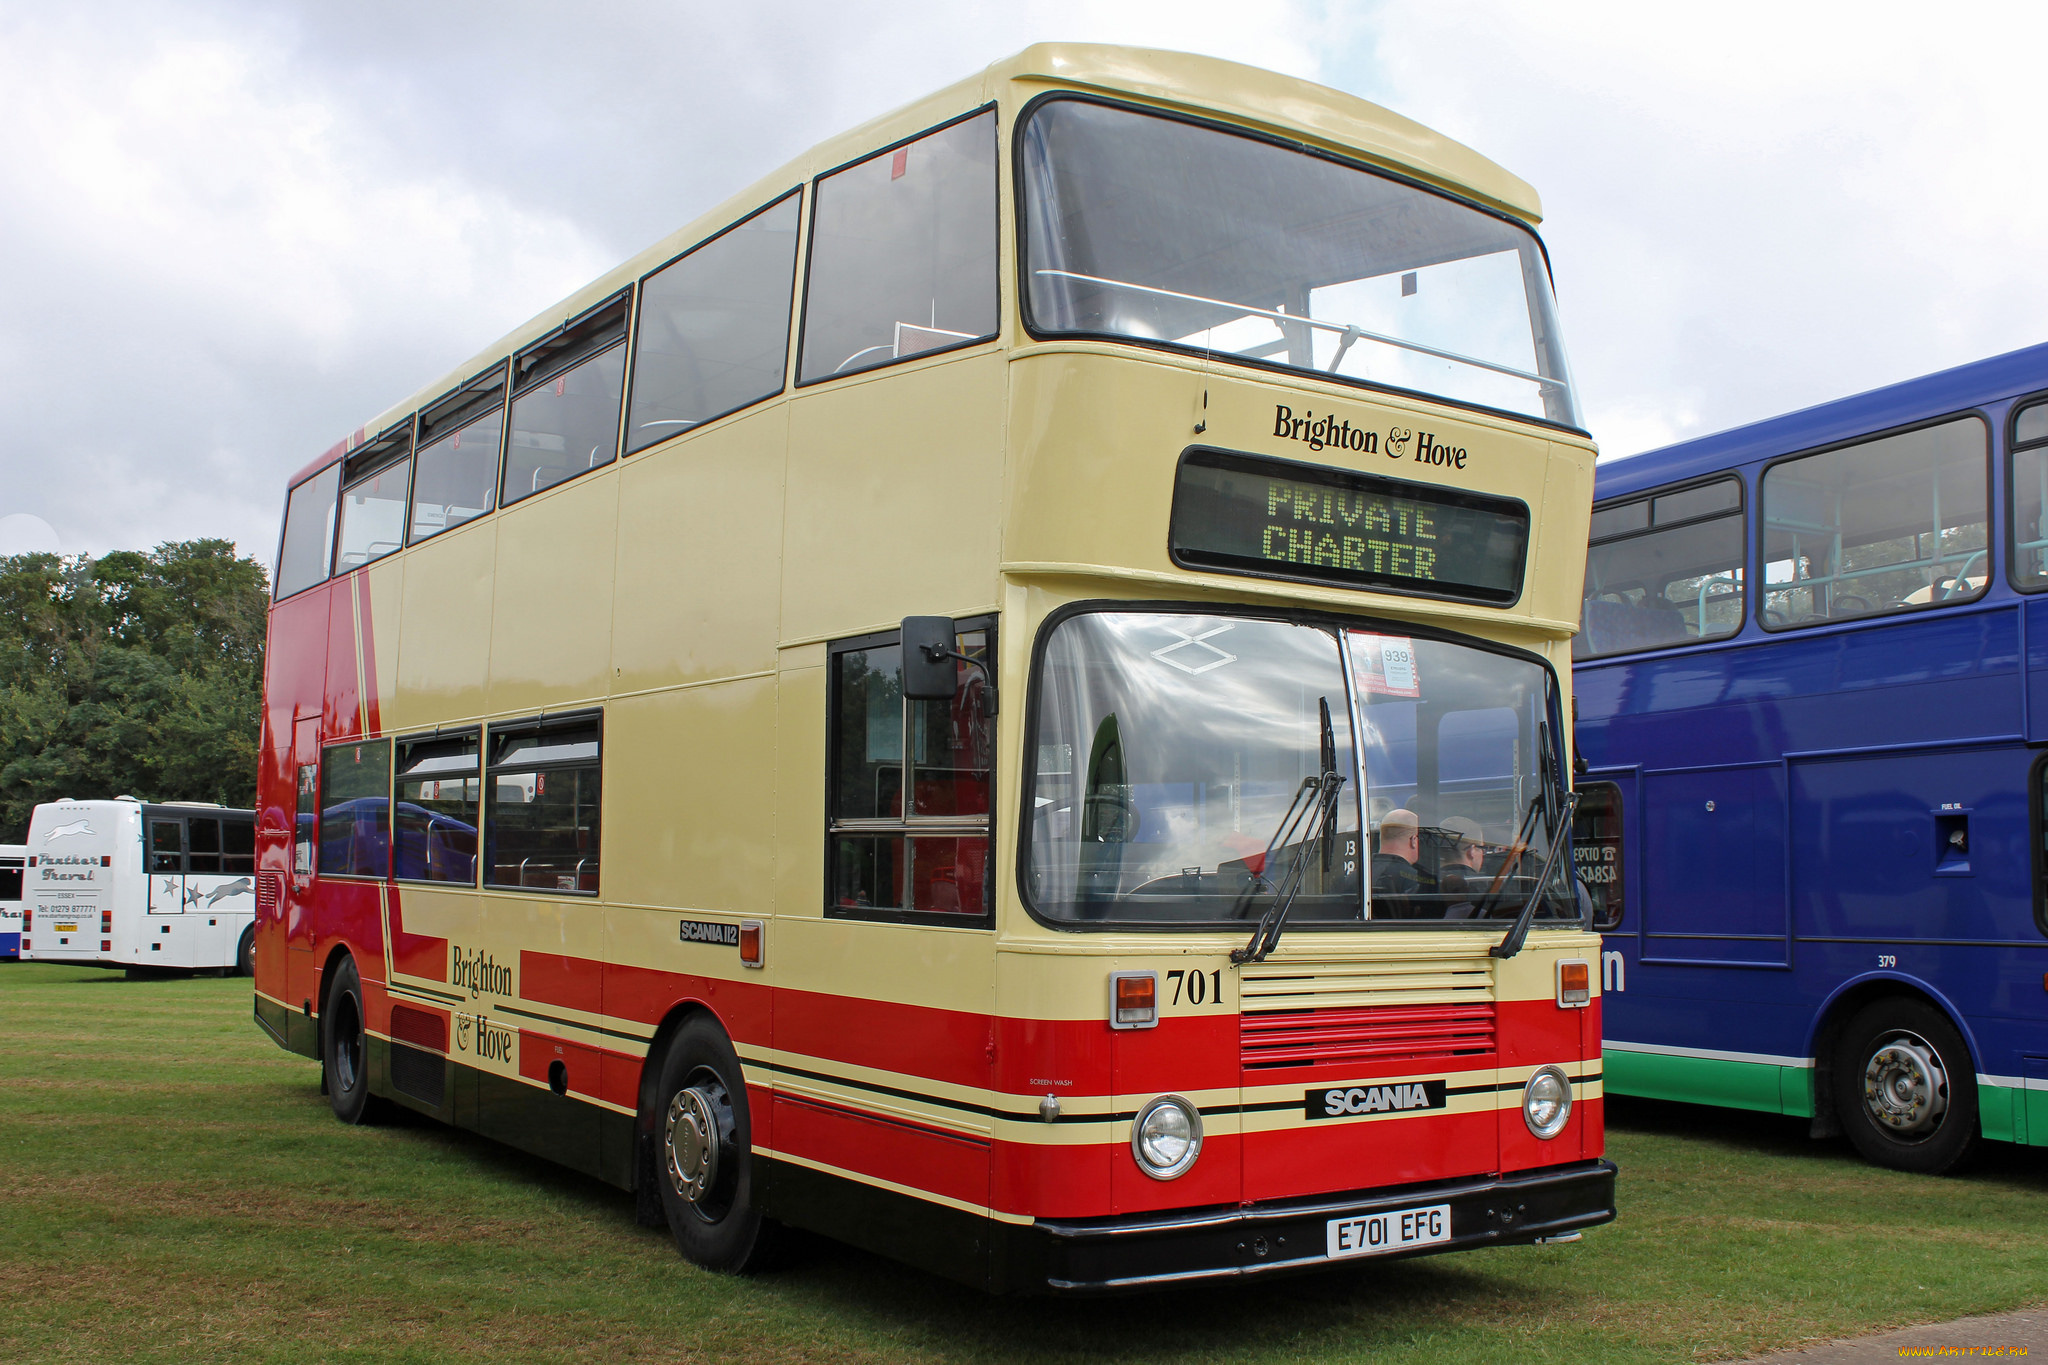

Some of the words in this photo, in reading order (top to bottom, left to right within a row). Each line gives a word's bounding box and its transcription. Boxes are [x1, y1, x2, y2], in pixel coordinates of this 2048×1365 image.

[1273, 404, 1379, 454] Brighton
[1385, 426, 1411, 459] &
[1414, 431, 1467, 470] Hove
[1268, 481, 1437, 540] PRIVATE
[1263, 524, 1436, 580] CHARTER
[1384, 649, 1409, 663] 939
[38, 852, 99, 866] Panther
[42, 868, 94, 881] Travel
[50, 905, 70, 913] 01279
[71, 905, 97, 913] 877771
[681, 921, 724, 942] SCANIA
[452, 945, 513, 1000] Brighton
[1878, 954, 1897, 968] 379
[1166, 968, 1224, 1005] 701
[456, 1011, 471, 1051] &
[476, 1014, 512, 1064] Hove
[1029, 1078, 1053, 1086] SCREEN
[1053, 1079, 1073, 1087] WASH
[1324, 1083, 1430, 1116] SCANIA
[1338, 1217, 1388, 1251] E701
[1401, 1210, 1442, 1242] EFG
